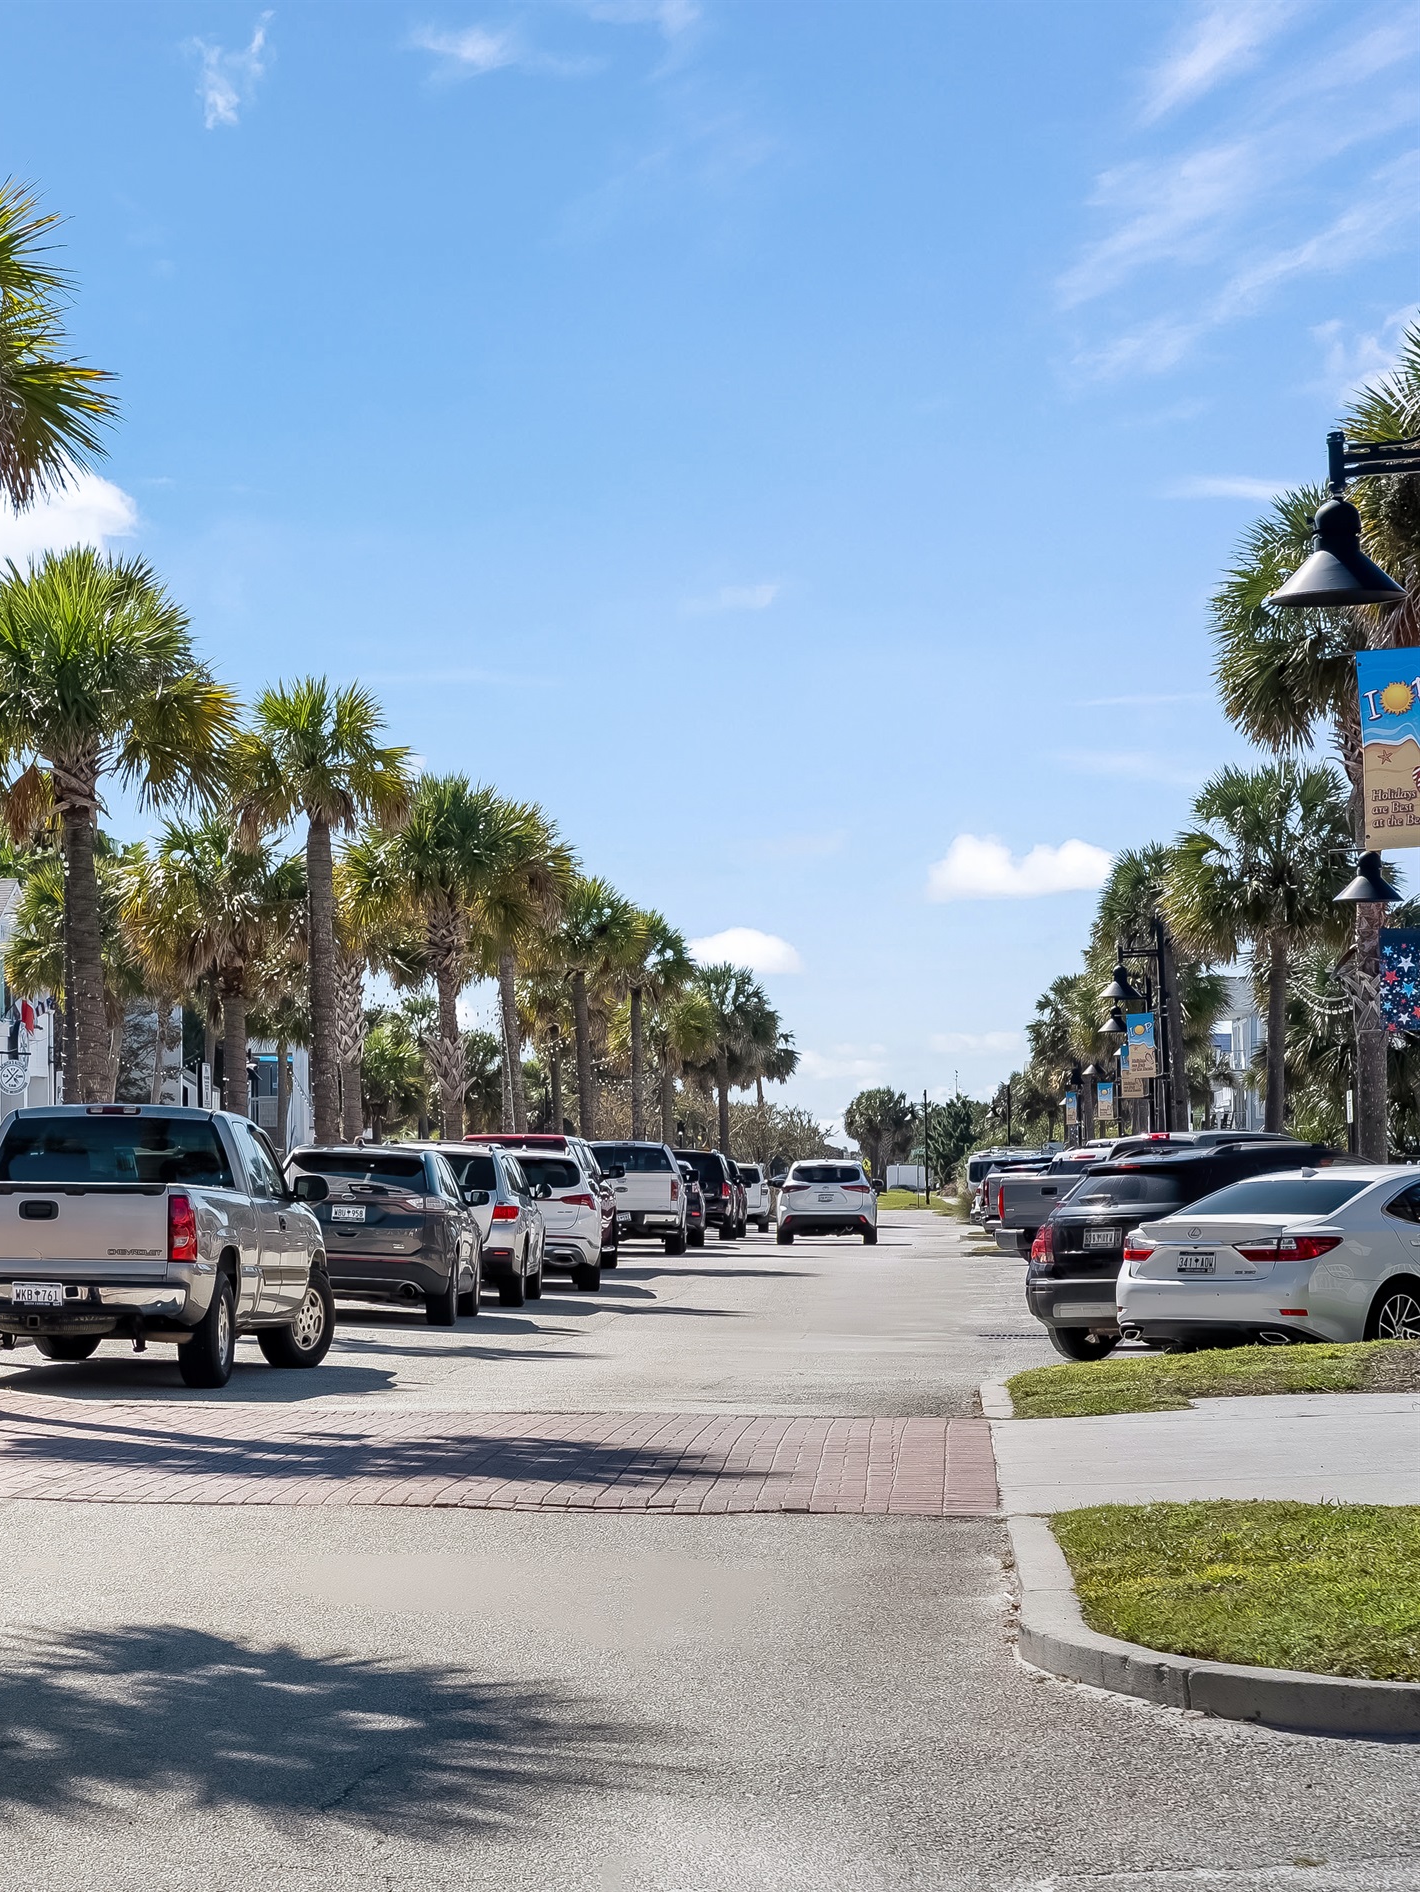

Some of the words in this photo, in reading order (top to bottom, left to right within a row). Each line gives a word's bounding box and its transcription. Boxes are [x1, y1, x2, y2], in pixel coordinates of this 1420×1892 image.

[1371, 787, 1417, 801] Holidays
[1372, 805, 1389, 815] are
[1391, 801, 1414, 813] Best
[1372, 818, 1384, 828] at
[1387, 815, 1403, 827] the
[1179, 1257, 1192, 1267] 341
[15, 1289, 33, 1301] WKB
[42, 1290, 58, 1302] 761
